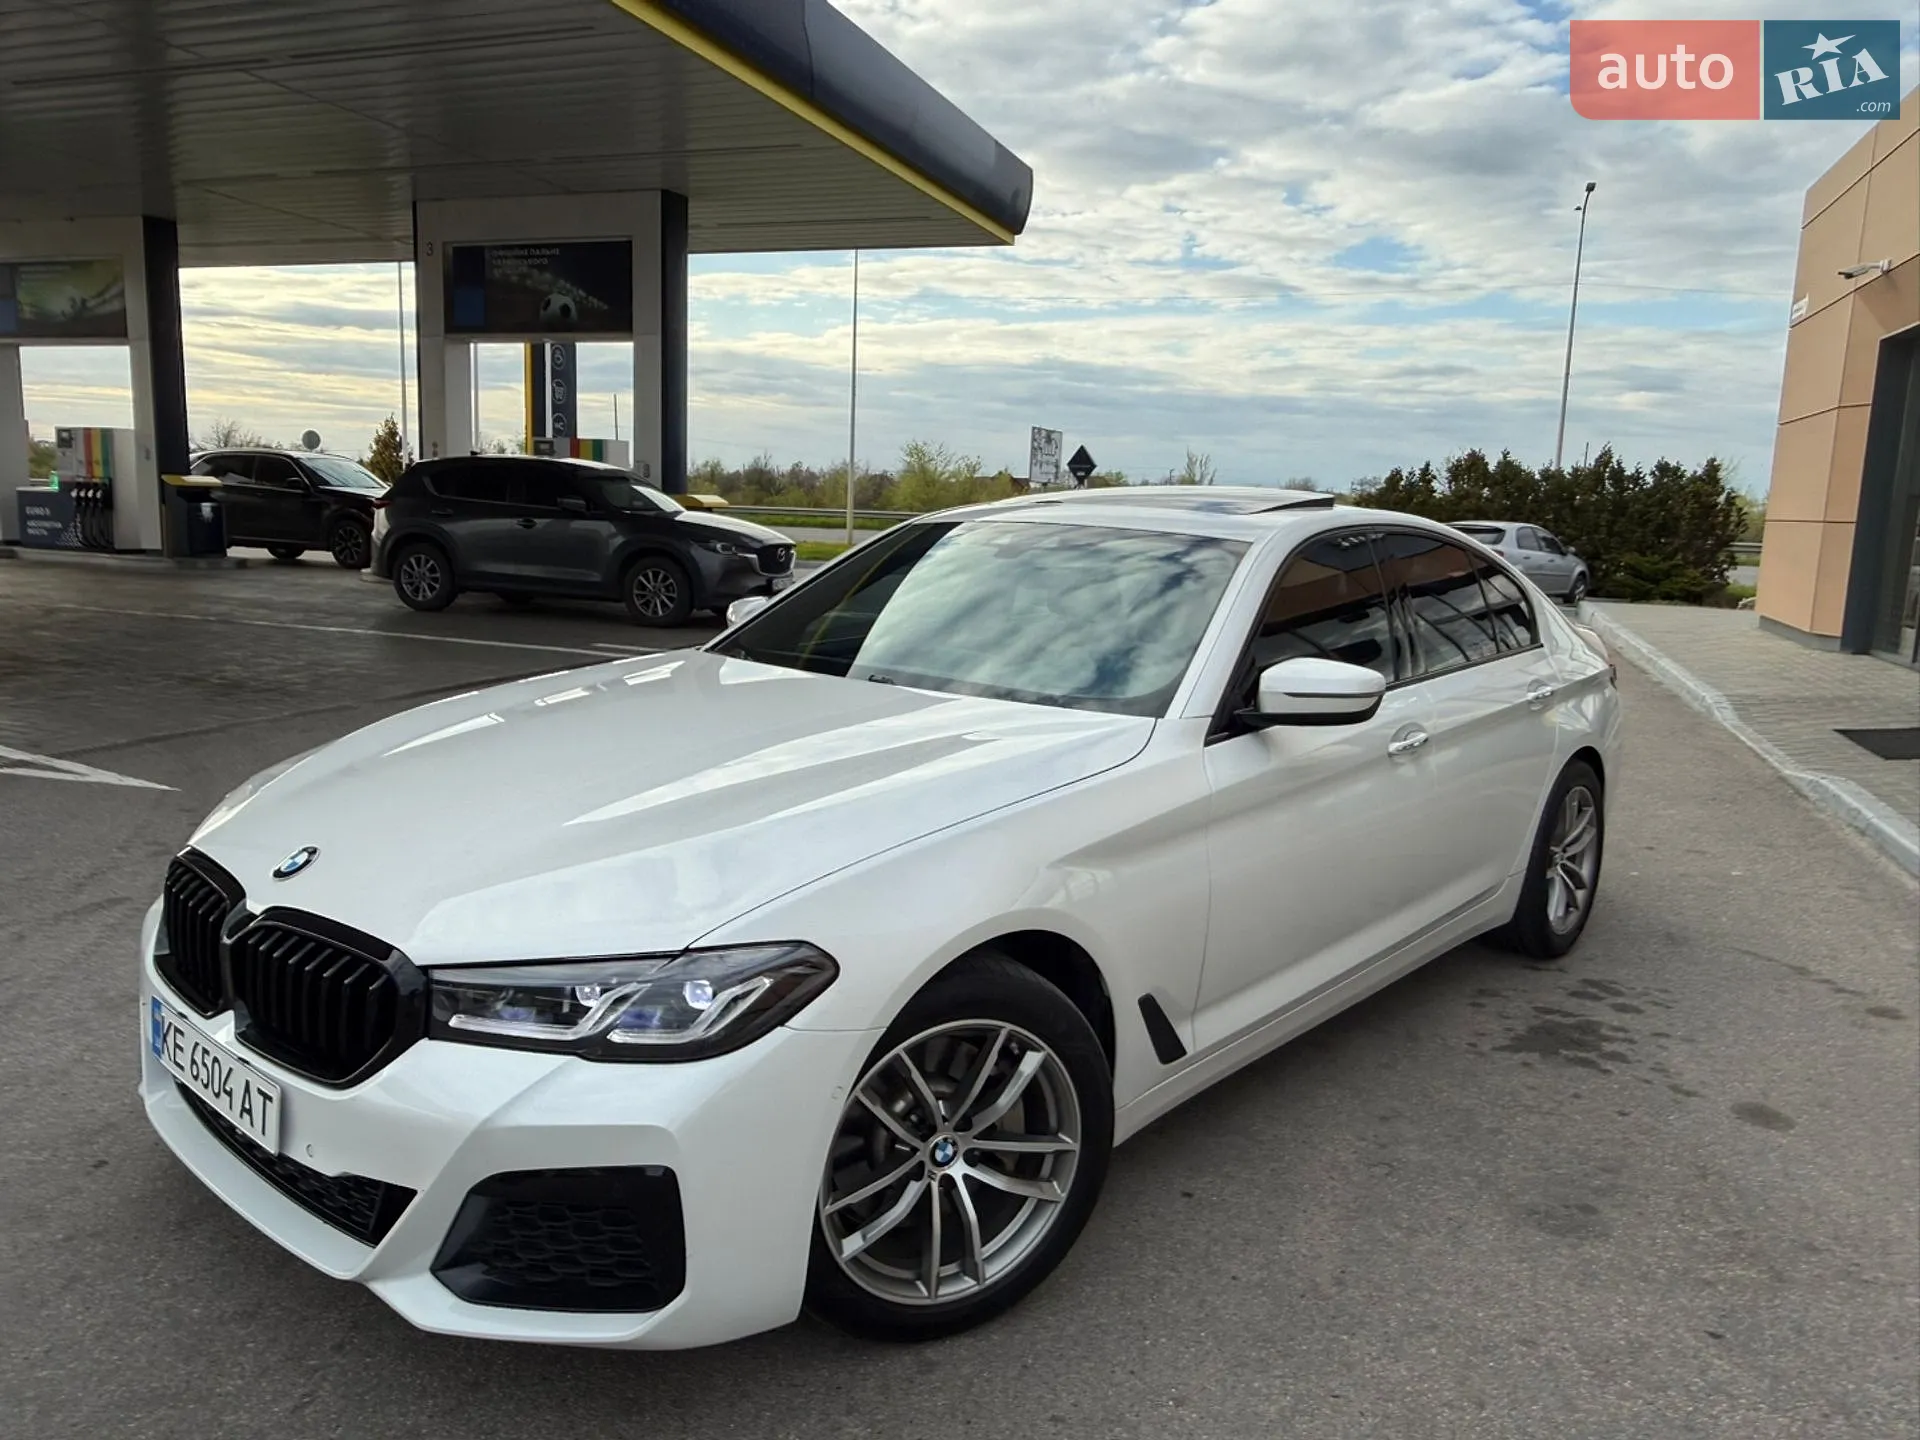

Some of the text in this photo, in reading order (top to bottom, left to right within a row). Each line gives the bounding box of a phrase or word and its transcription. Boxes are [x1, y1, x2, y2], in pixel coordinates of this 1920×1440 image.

[161, 1015, 274, 1137] KE 6504 AT
